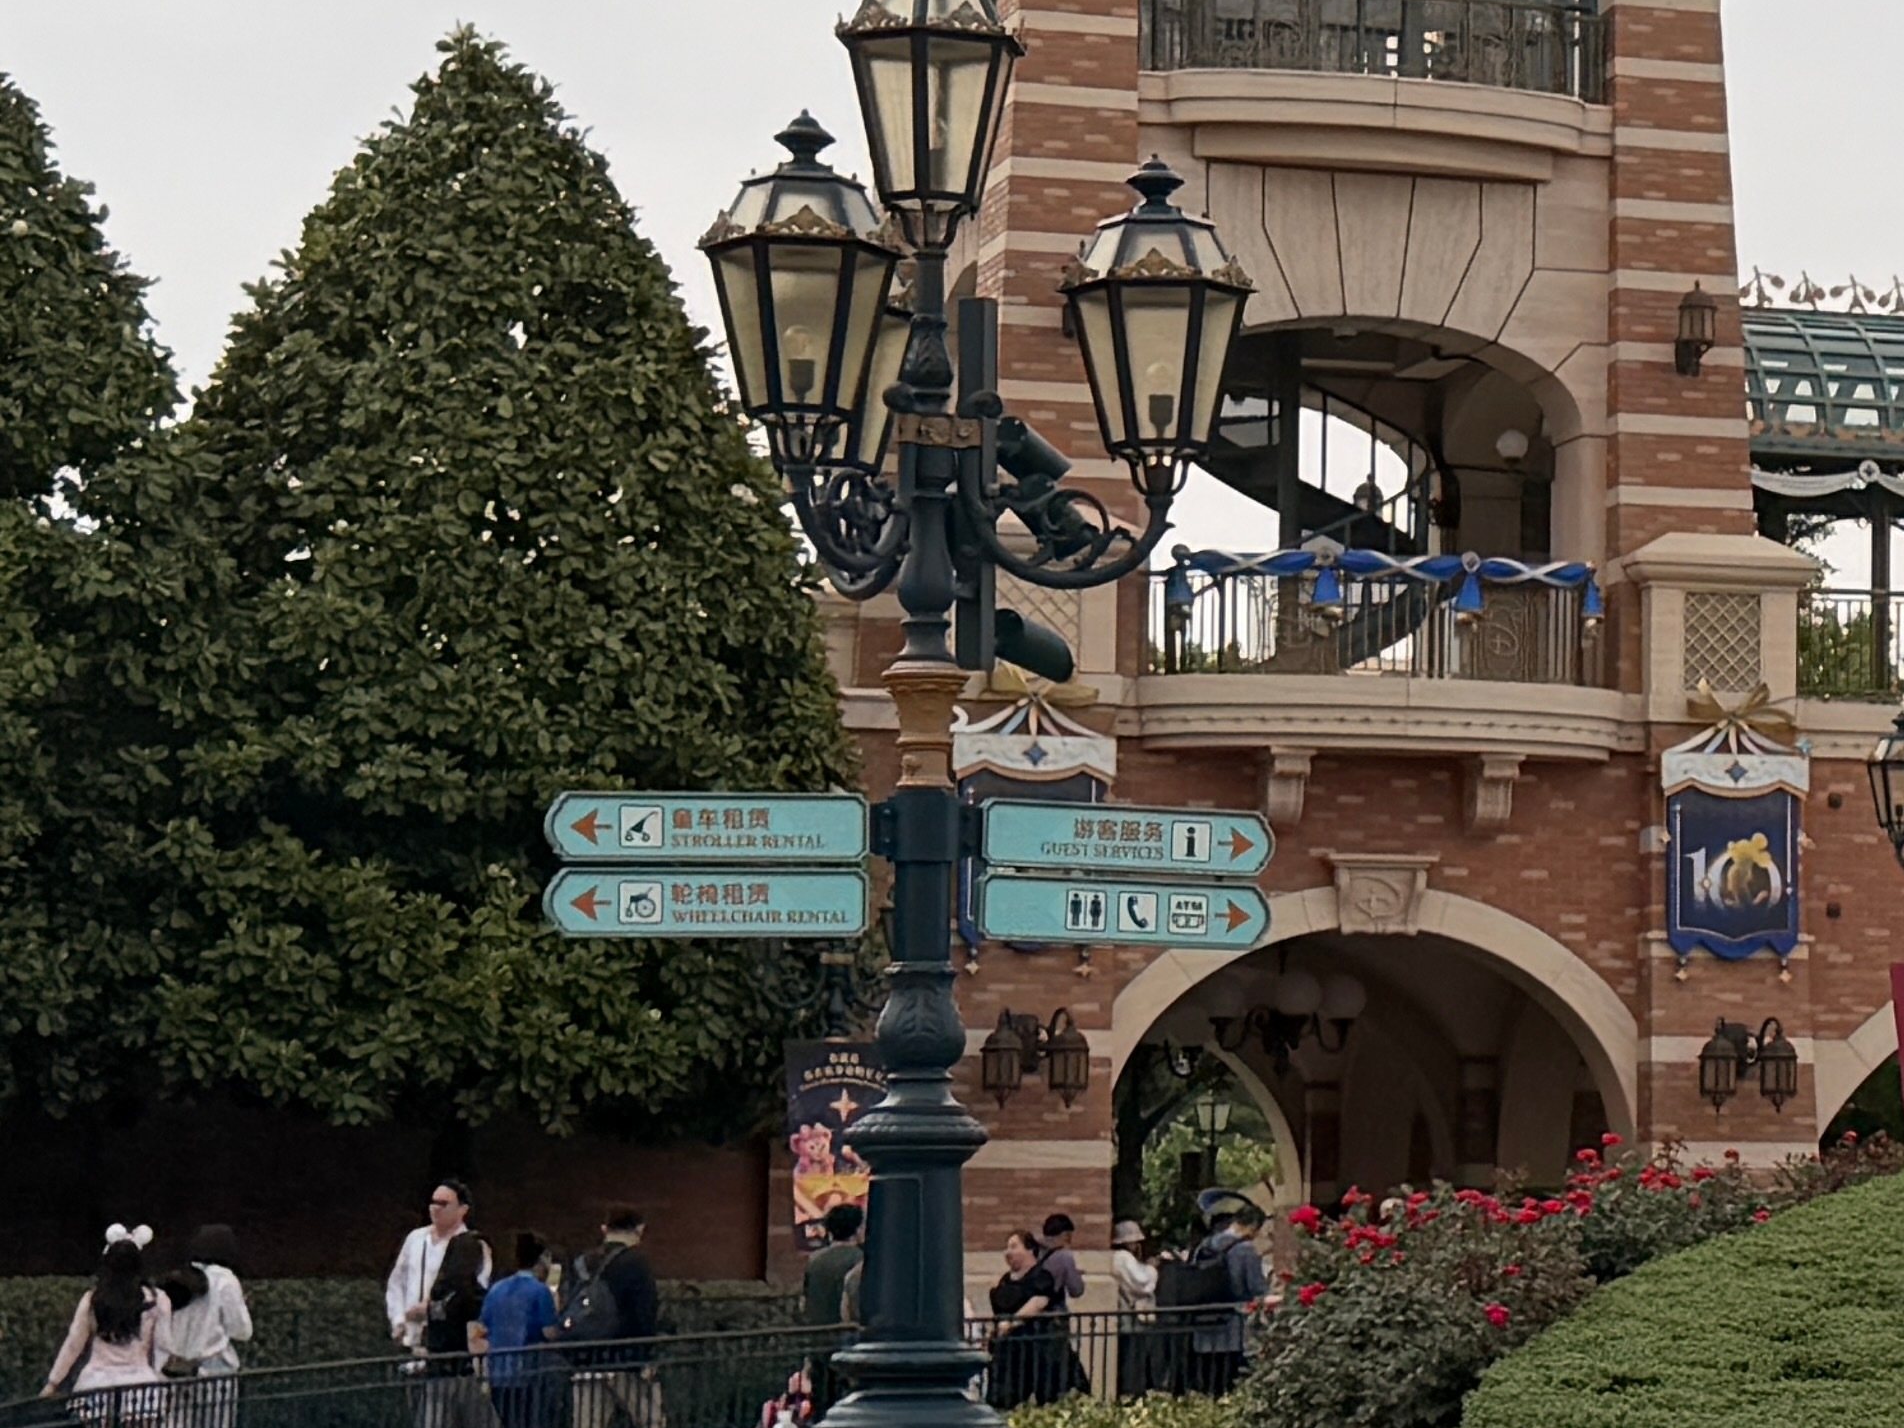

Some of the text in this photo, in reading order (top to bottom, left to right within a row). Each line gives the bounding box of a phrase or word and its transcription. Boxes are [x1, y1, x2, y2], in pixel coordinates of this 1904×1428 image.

[1074, 816, 1163, 842] 游客服务
[671, 834, 825, 849] STROLLER RENTAL
[1041, 841, 1164, 860] GUEST SERVICES
[1175, 900, 1203, 911] ATM
[671, 909, 848, 924] WHEELCHAIR RENTAL
